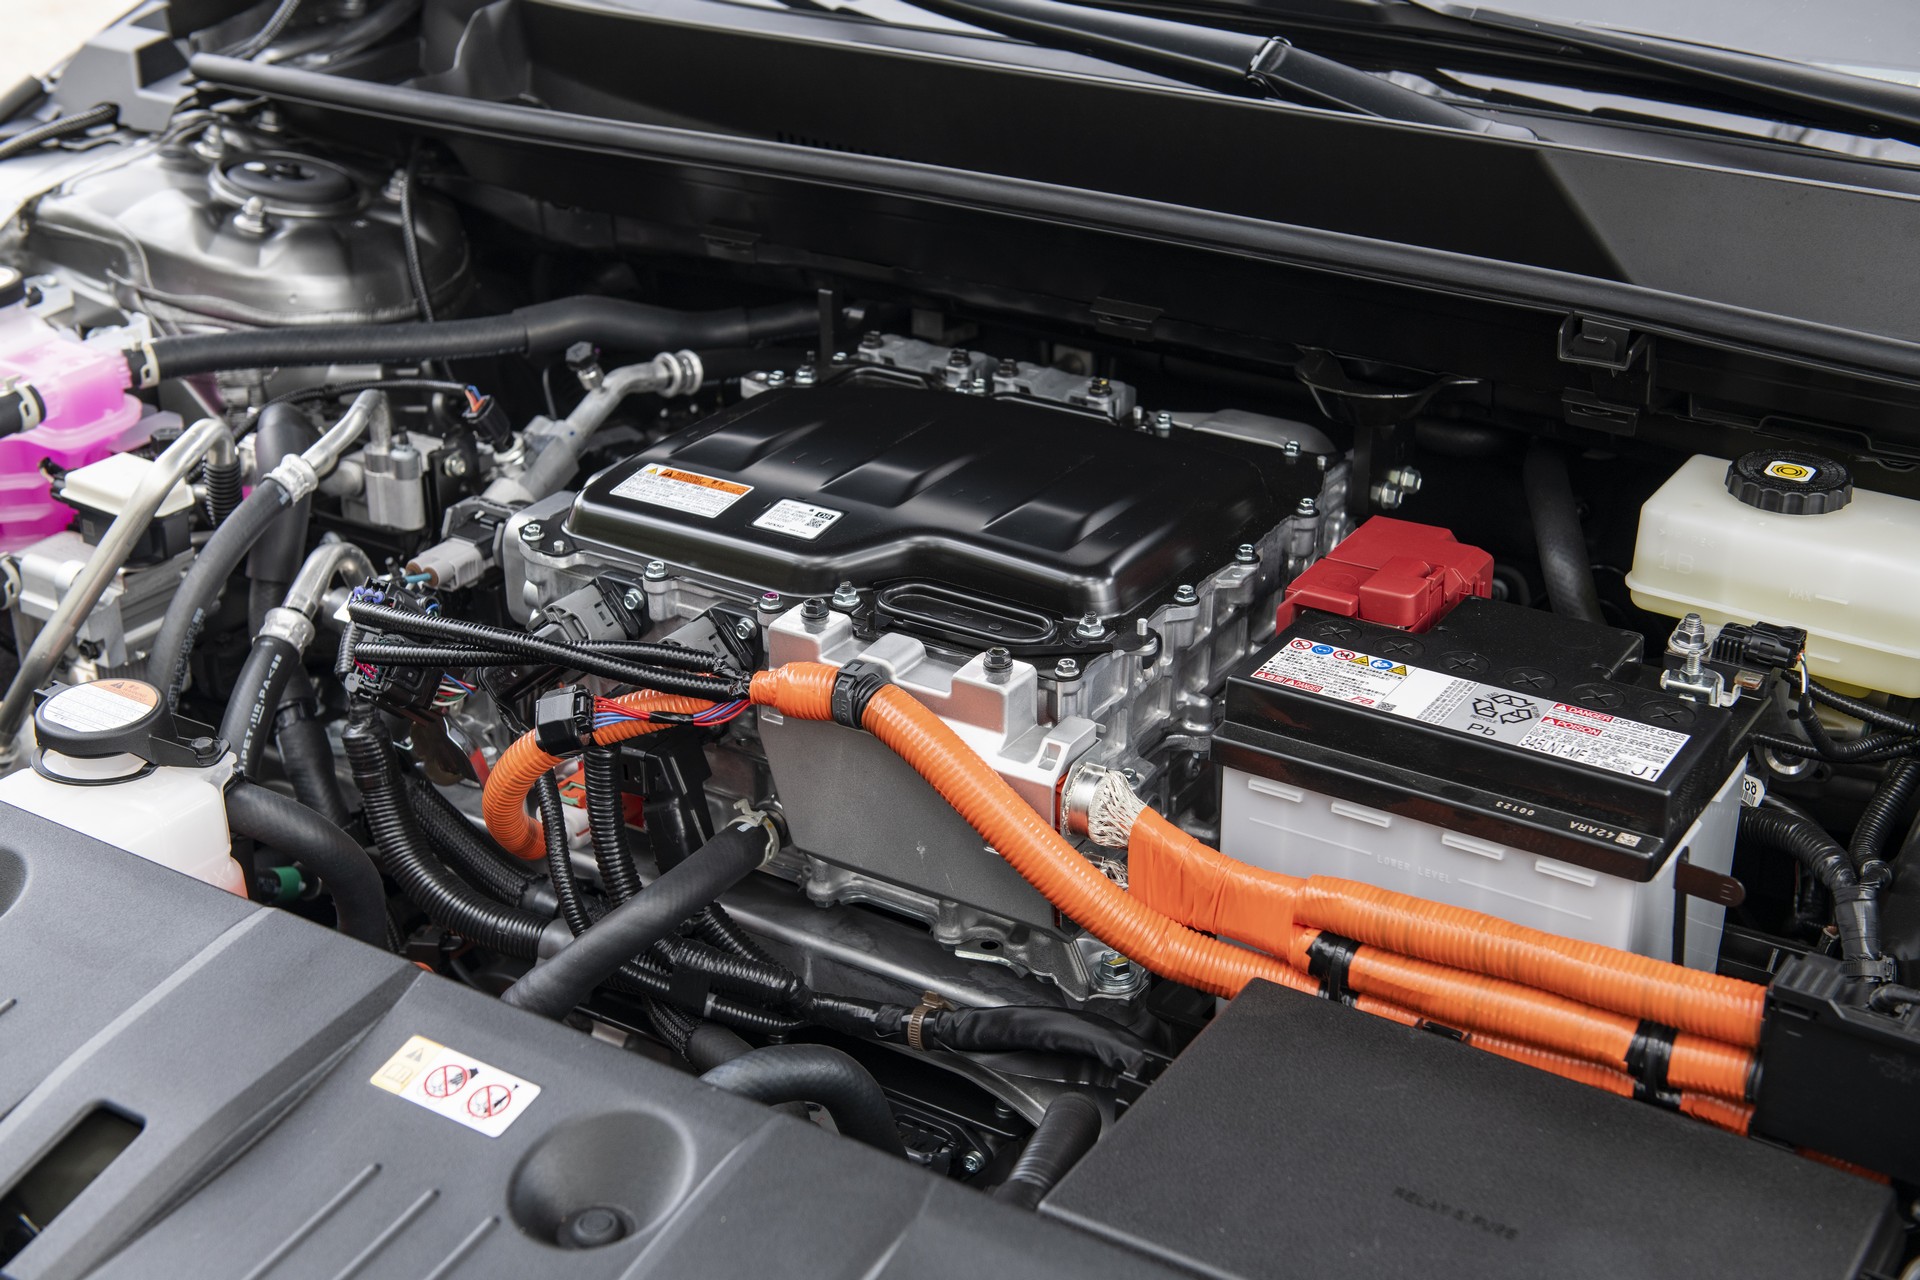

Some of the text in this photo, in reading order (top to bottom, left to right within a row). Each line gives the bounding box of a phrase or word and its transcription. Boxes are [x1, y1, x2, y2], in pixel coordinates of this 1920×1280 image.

[1293, 681, 1322, 692] DANGER
[1467, 723, 1496, 736] Pb
[1567, 707, 1686, 740] DANGER EXPLOSIVE GASES
[1521, 736, 1588, 759] 345LN1-MF
[1555, 720, 1675, 754] POISON CAUSES SEVERE BURNS
[1496, 801, 1535, 816] 00123
[1570, 820, 1616, 839] 42ARA
[1377, 854, 1452, 884] LOWER LEVEL
